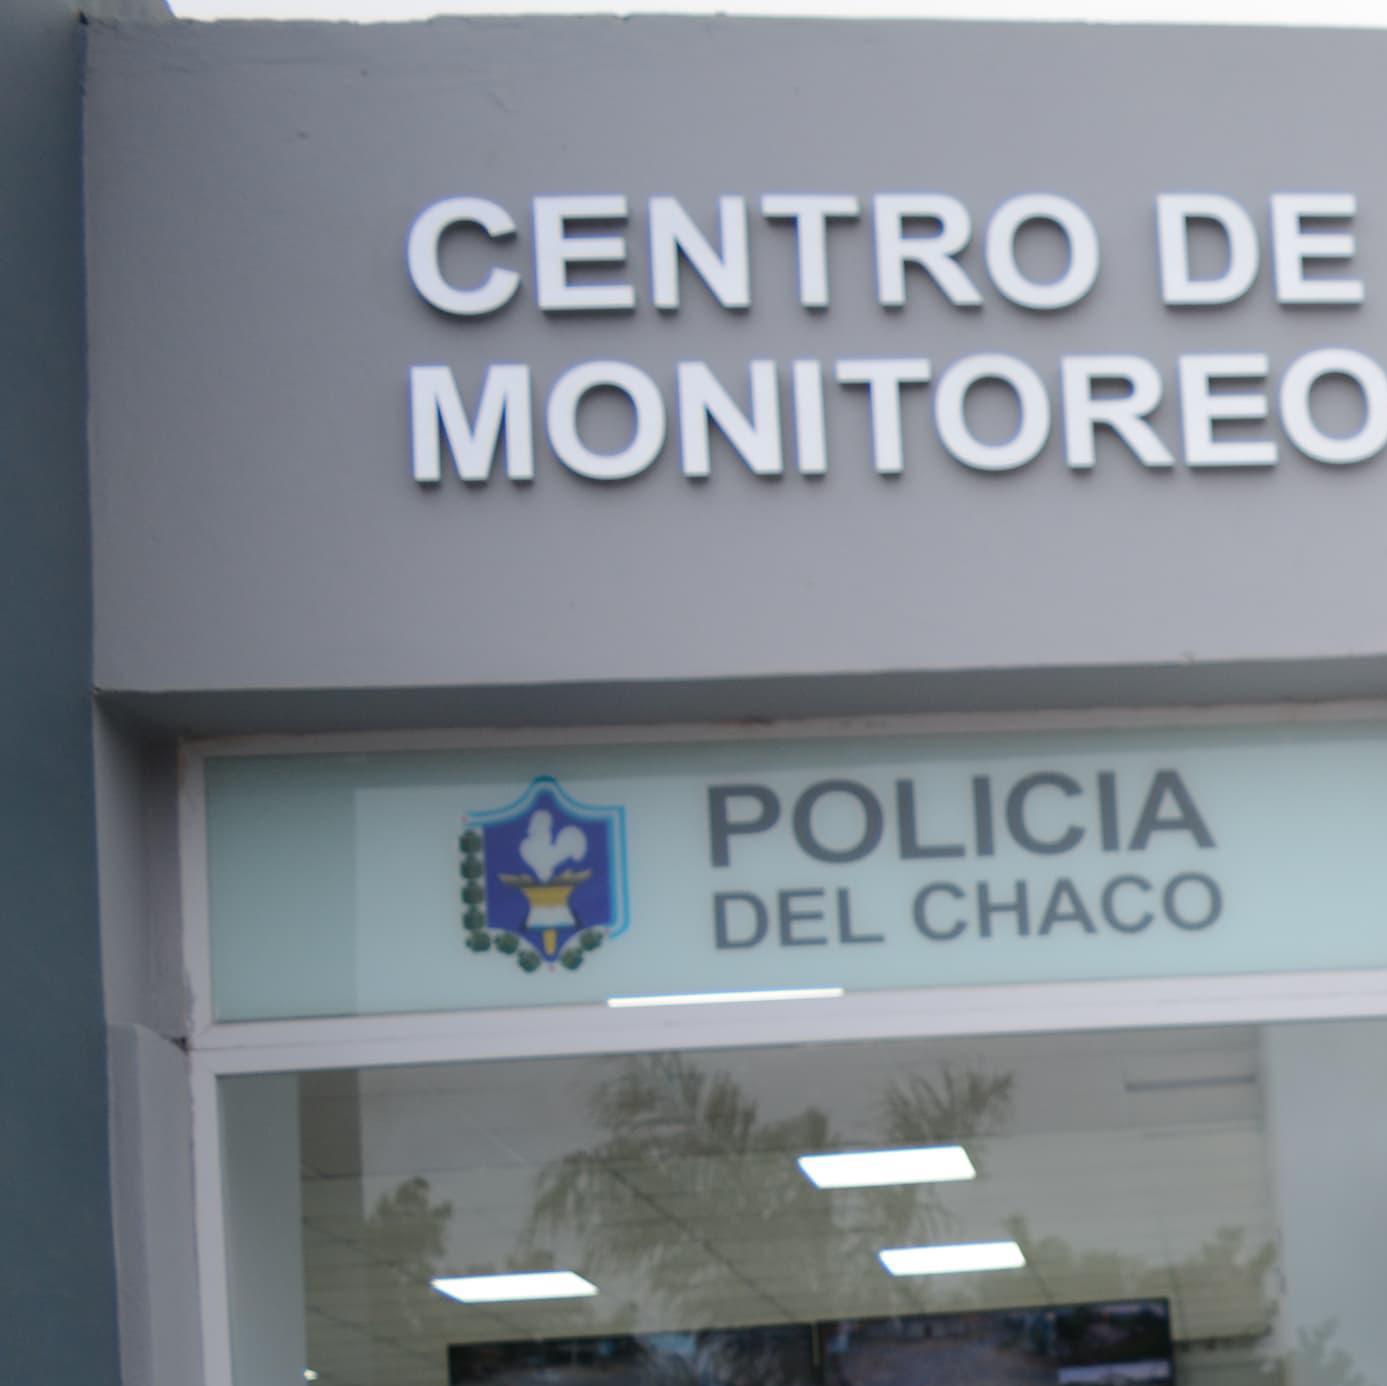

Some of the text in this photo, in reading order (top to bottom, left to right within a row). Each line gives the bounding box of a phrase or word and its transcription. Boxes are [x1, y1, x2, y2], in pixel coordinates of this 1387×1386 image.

[408, 192, 1366, 316] CENTRO DE
[706, 768, 1218, 868] POLICIA
[712, 872, 1224, 951] DEL CHACO
